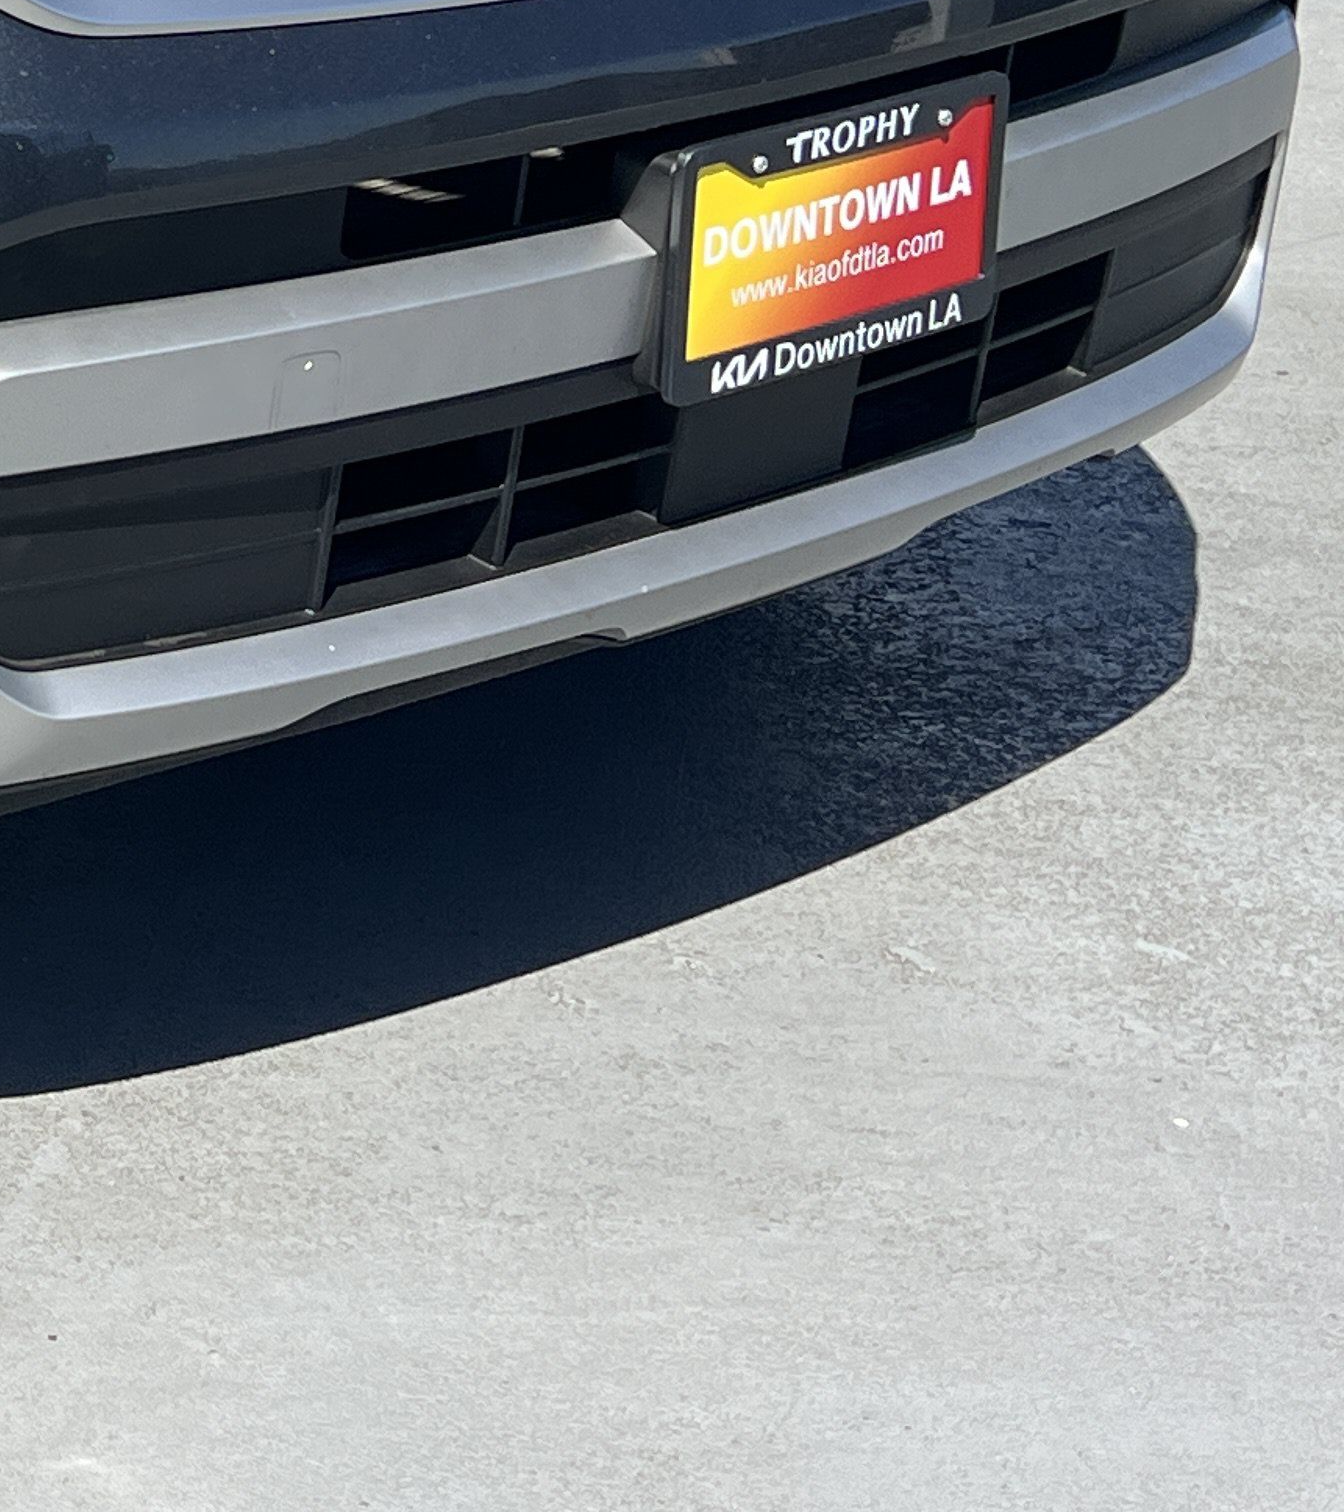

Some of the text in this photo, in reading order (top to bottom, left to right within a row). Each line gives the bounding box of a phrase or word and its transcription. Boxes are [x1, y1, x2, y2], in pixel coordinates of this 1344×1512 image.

[786, 102, 921, 164] TROPHY
[703, 159, 973, 268] DOWNTOWN LA
[730, 227, 945, 308] www.kiaofdtla.com
[710, 292, 963, 395] KIA Downtown LA
